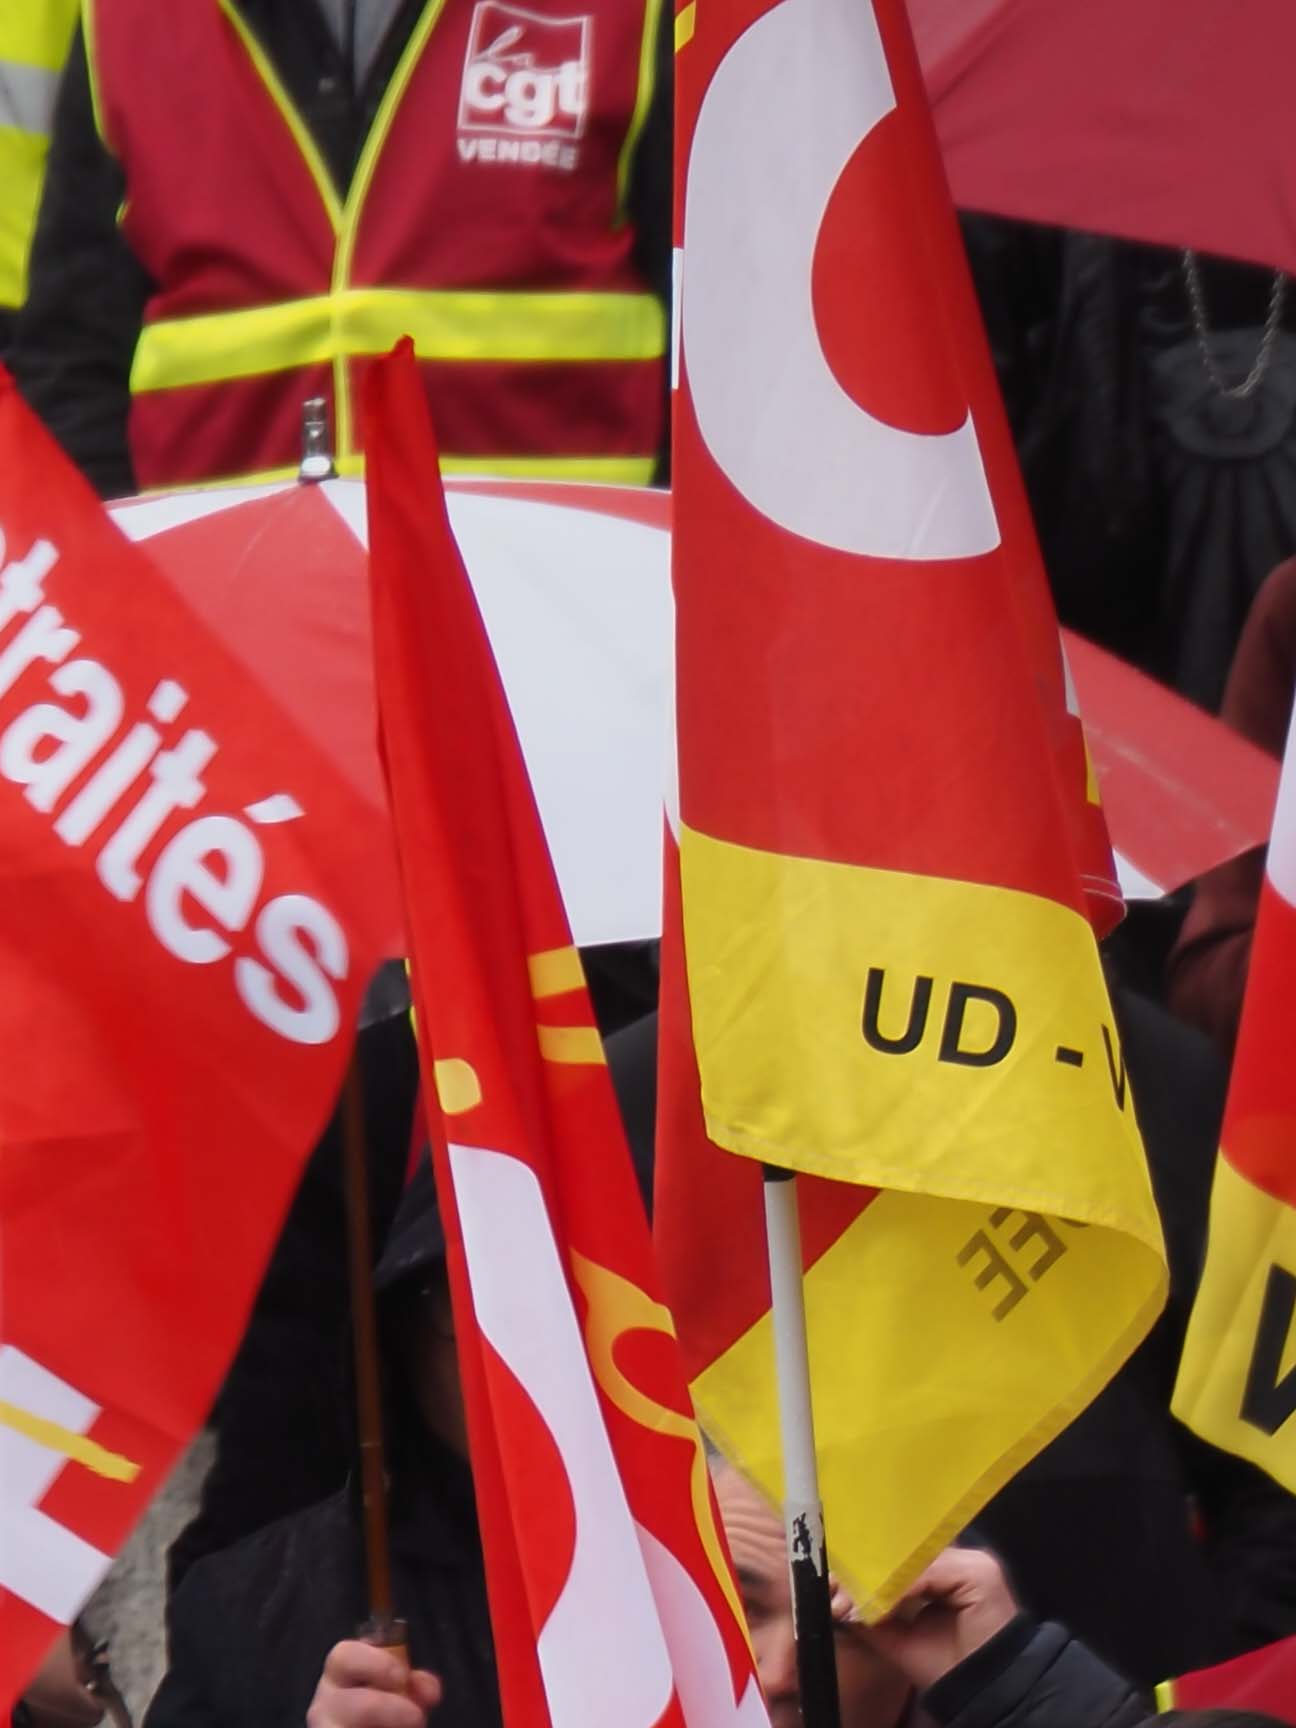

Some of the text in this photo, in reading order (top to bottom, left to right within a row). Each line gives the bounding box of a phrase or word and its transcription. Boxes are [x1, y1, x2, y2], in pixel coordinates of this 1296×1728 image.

[465, 60, 589, 128] cgt
[458, 138, 578, 171] VENDÉE
[861, 967, 1018, 1068] UD
